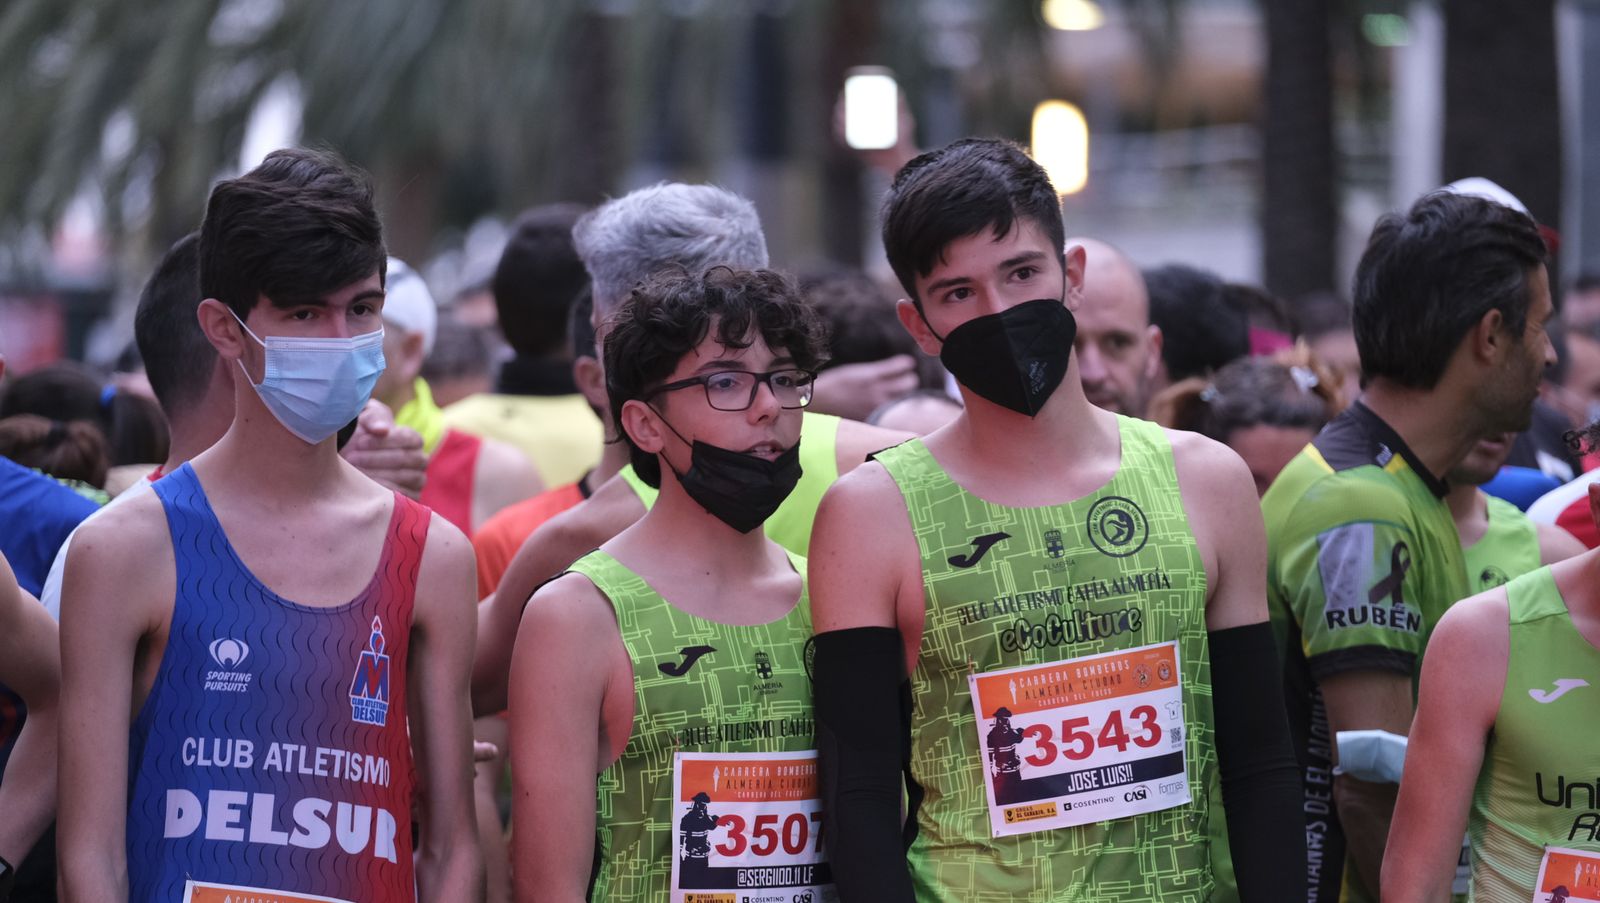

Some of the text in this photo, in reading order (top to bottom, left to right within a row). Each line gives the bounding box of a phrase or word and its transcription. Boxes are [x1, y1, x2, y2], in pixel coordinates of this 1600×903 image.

[993, 591, 1063, 615] ATLETISMO
[1112, 567, 1170, 596] ALMERÍA
[1001, 608, 1142, 652] eCoCulture
[206, 671, 252, 682] SPORTING
[1020, 671, 1068, 688] CARRERA
[1076, 660, 1130, 678] BOMBEROS
[1083, 674, 1122, 690] CIUDAD
[204, 681, 248, 692] PURSUITS
[716, 720, 774, 741] ATLETISMO
[1022, 704, 1162, 767] 3543
[182, 736, 390, 788] CLUB ATLETISMO
[724, 766, 770, 776] CARRERA
[1068, 763, 1134, 792] JOSE LUIS!!
[1306, 766, 1331, 783] EL
[1159, 781, 1184, 795] formas
[1073, 796, 1114, 808] COSENTINO
[1304, 791, 1331, 816] DE
[164, 789, 397, 864] DELSUR
[715, 813, 825, 857] 3507
[803, 866, 814, 884] LF
